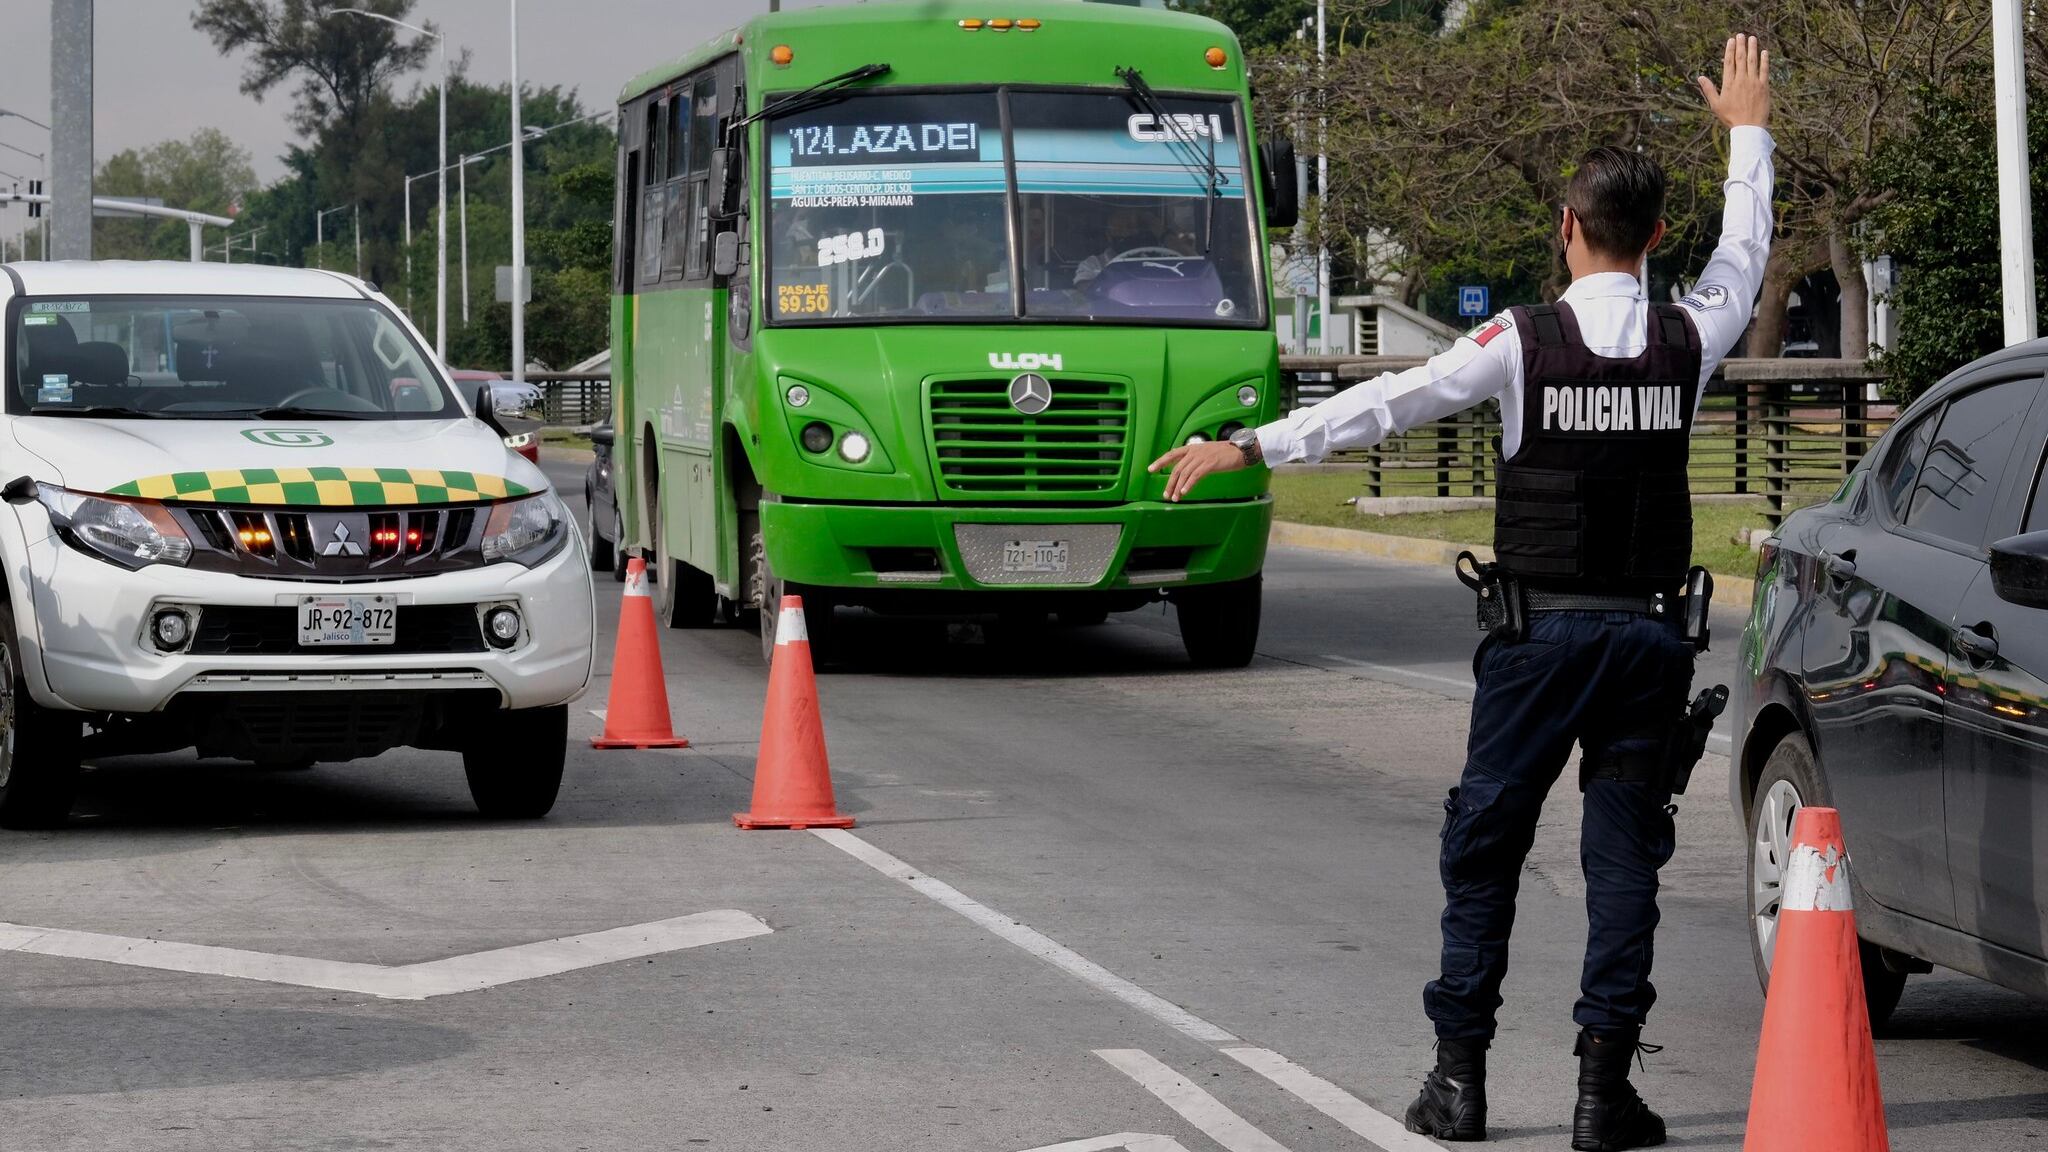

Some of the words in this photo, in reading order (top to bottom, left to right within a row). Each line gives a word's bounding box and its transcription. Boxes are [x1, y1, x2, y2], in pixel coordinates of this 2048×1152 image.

[814, 184, 825, 194] DE
[884, 183, 899, 193] DEL
[899, 183, 913, 193] SOL
[860, 195, 914, 206] 9-MIRAMAR
[778, 284, 829, 296] PASAJE
[779, 294, 829, 314] $9.50
[1543, 385, 1634, 432] POLICIA
[1638, 385, 1682, 430] VIAL
[1006, 549, 1066, 563] 721-110-G
[303, 608, 393, 631] JR-92-872
[322, 632, 350, 641] Jalisco
